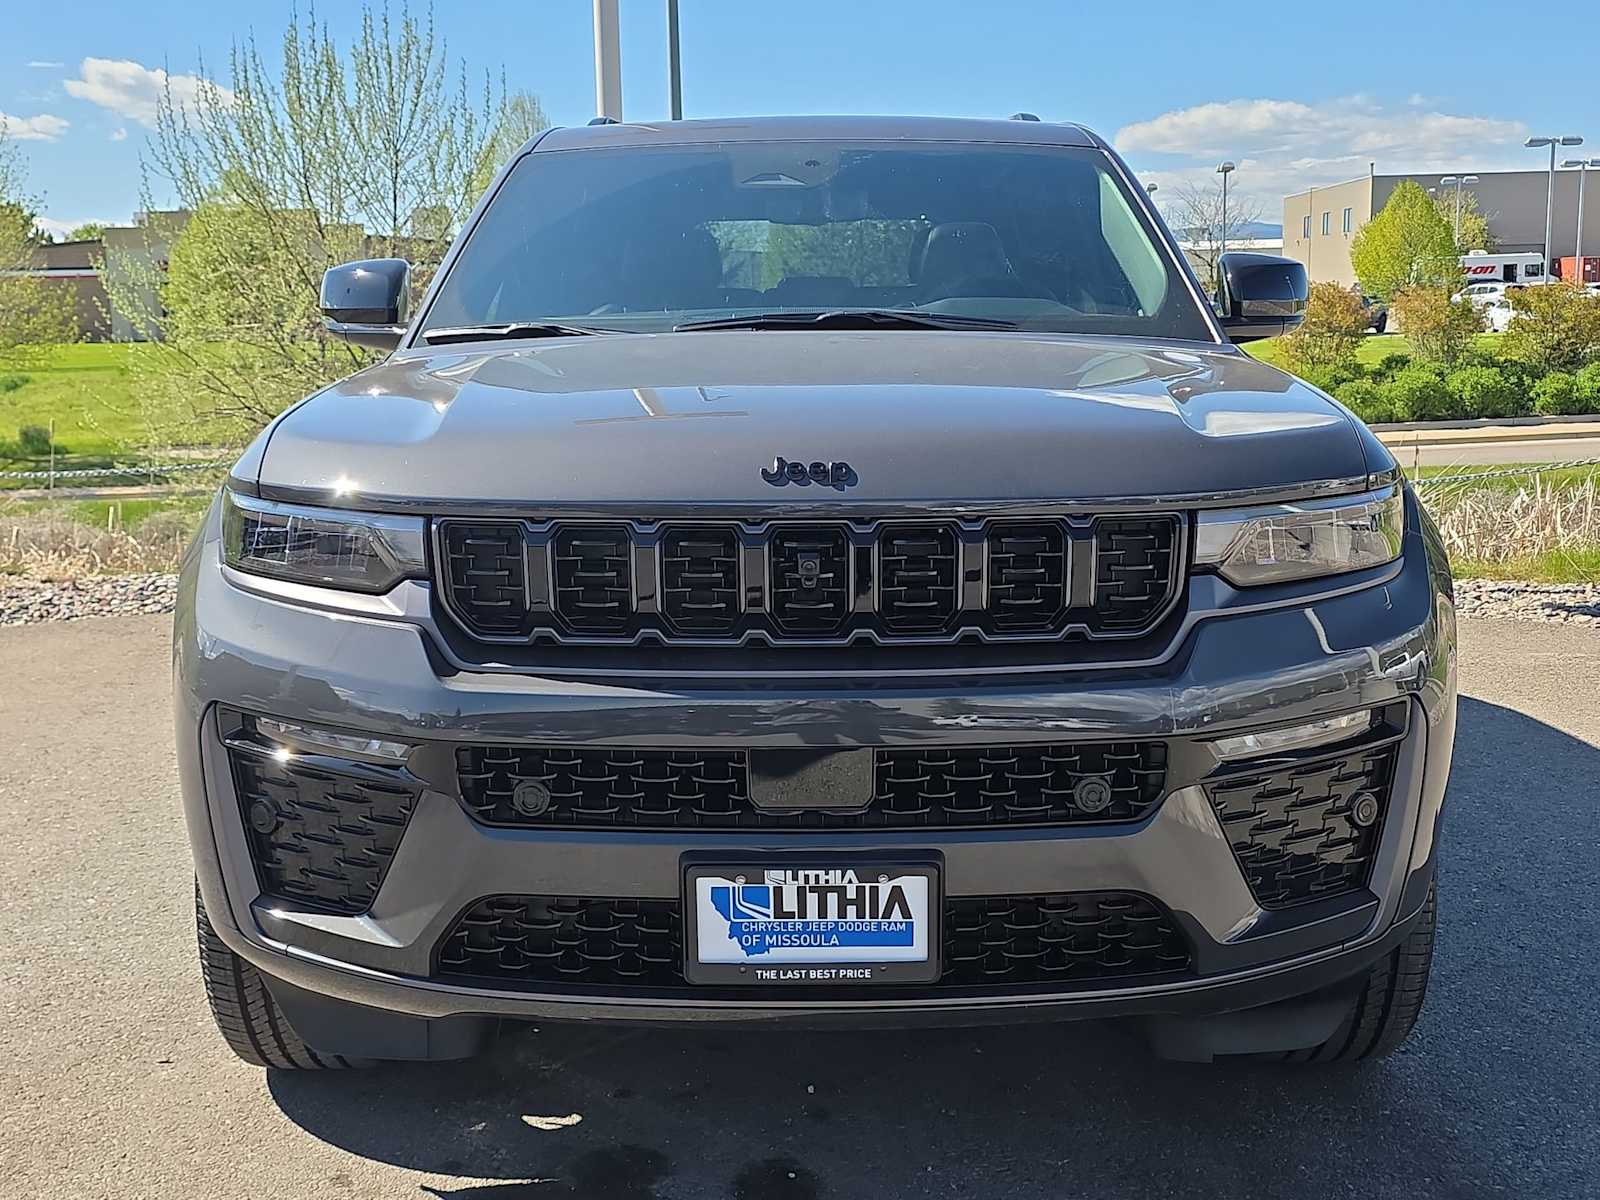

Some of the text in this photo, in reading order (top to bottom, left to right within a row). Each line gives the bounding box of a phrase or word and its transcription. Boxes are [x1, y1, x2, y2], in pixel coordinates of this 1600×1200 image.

[760, 456, 859, 492] Jeep
[786, 869, 859, 885] LITHIA
[773, 885, 913, 920] LITHIA
[741, 921, 906, 932] CHRYSLER JEEP DODGE RAM
[741, 934, 840, 946] OF MISSOULA
[756, 968, 872, 980] THE LAST BEST PRICE
